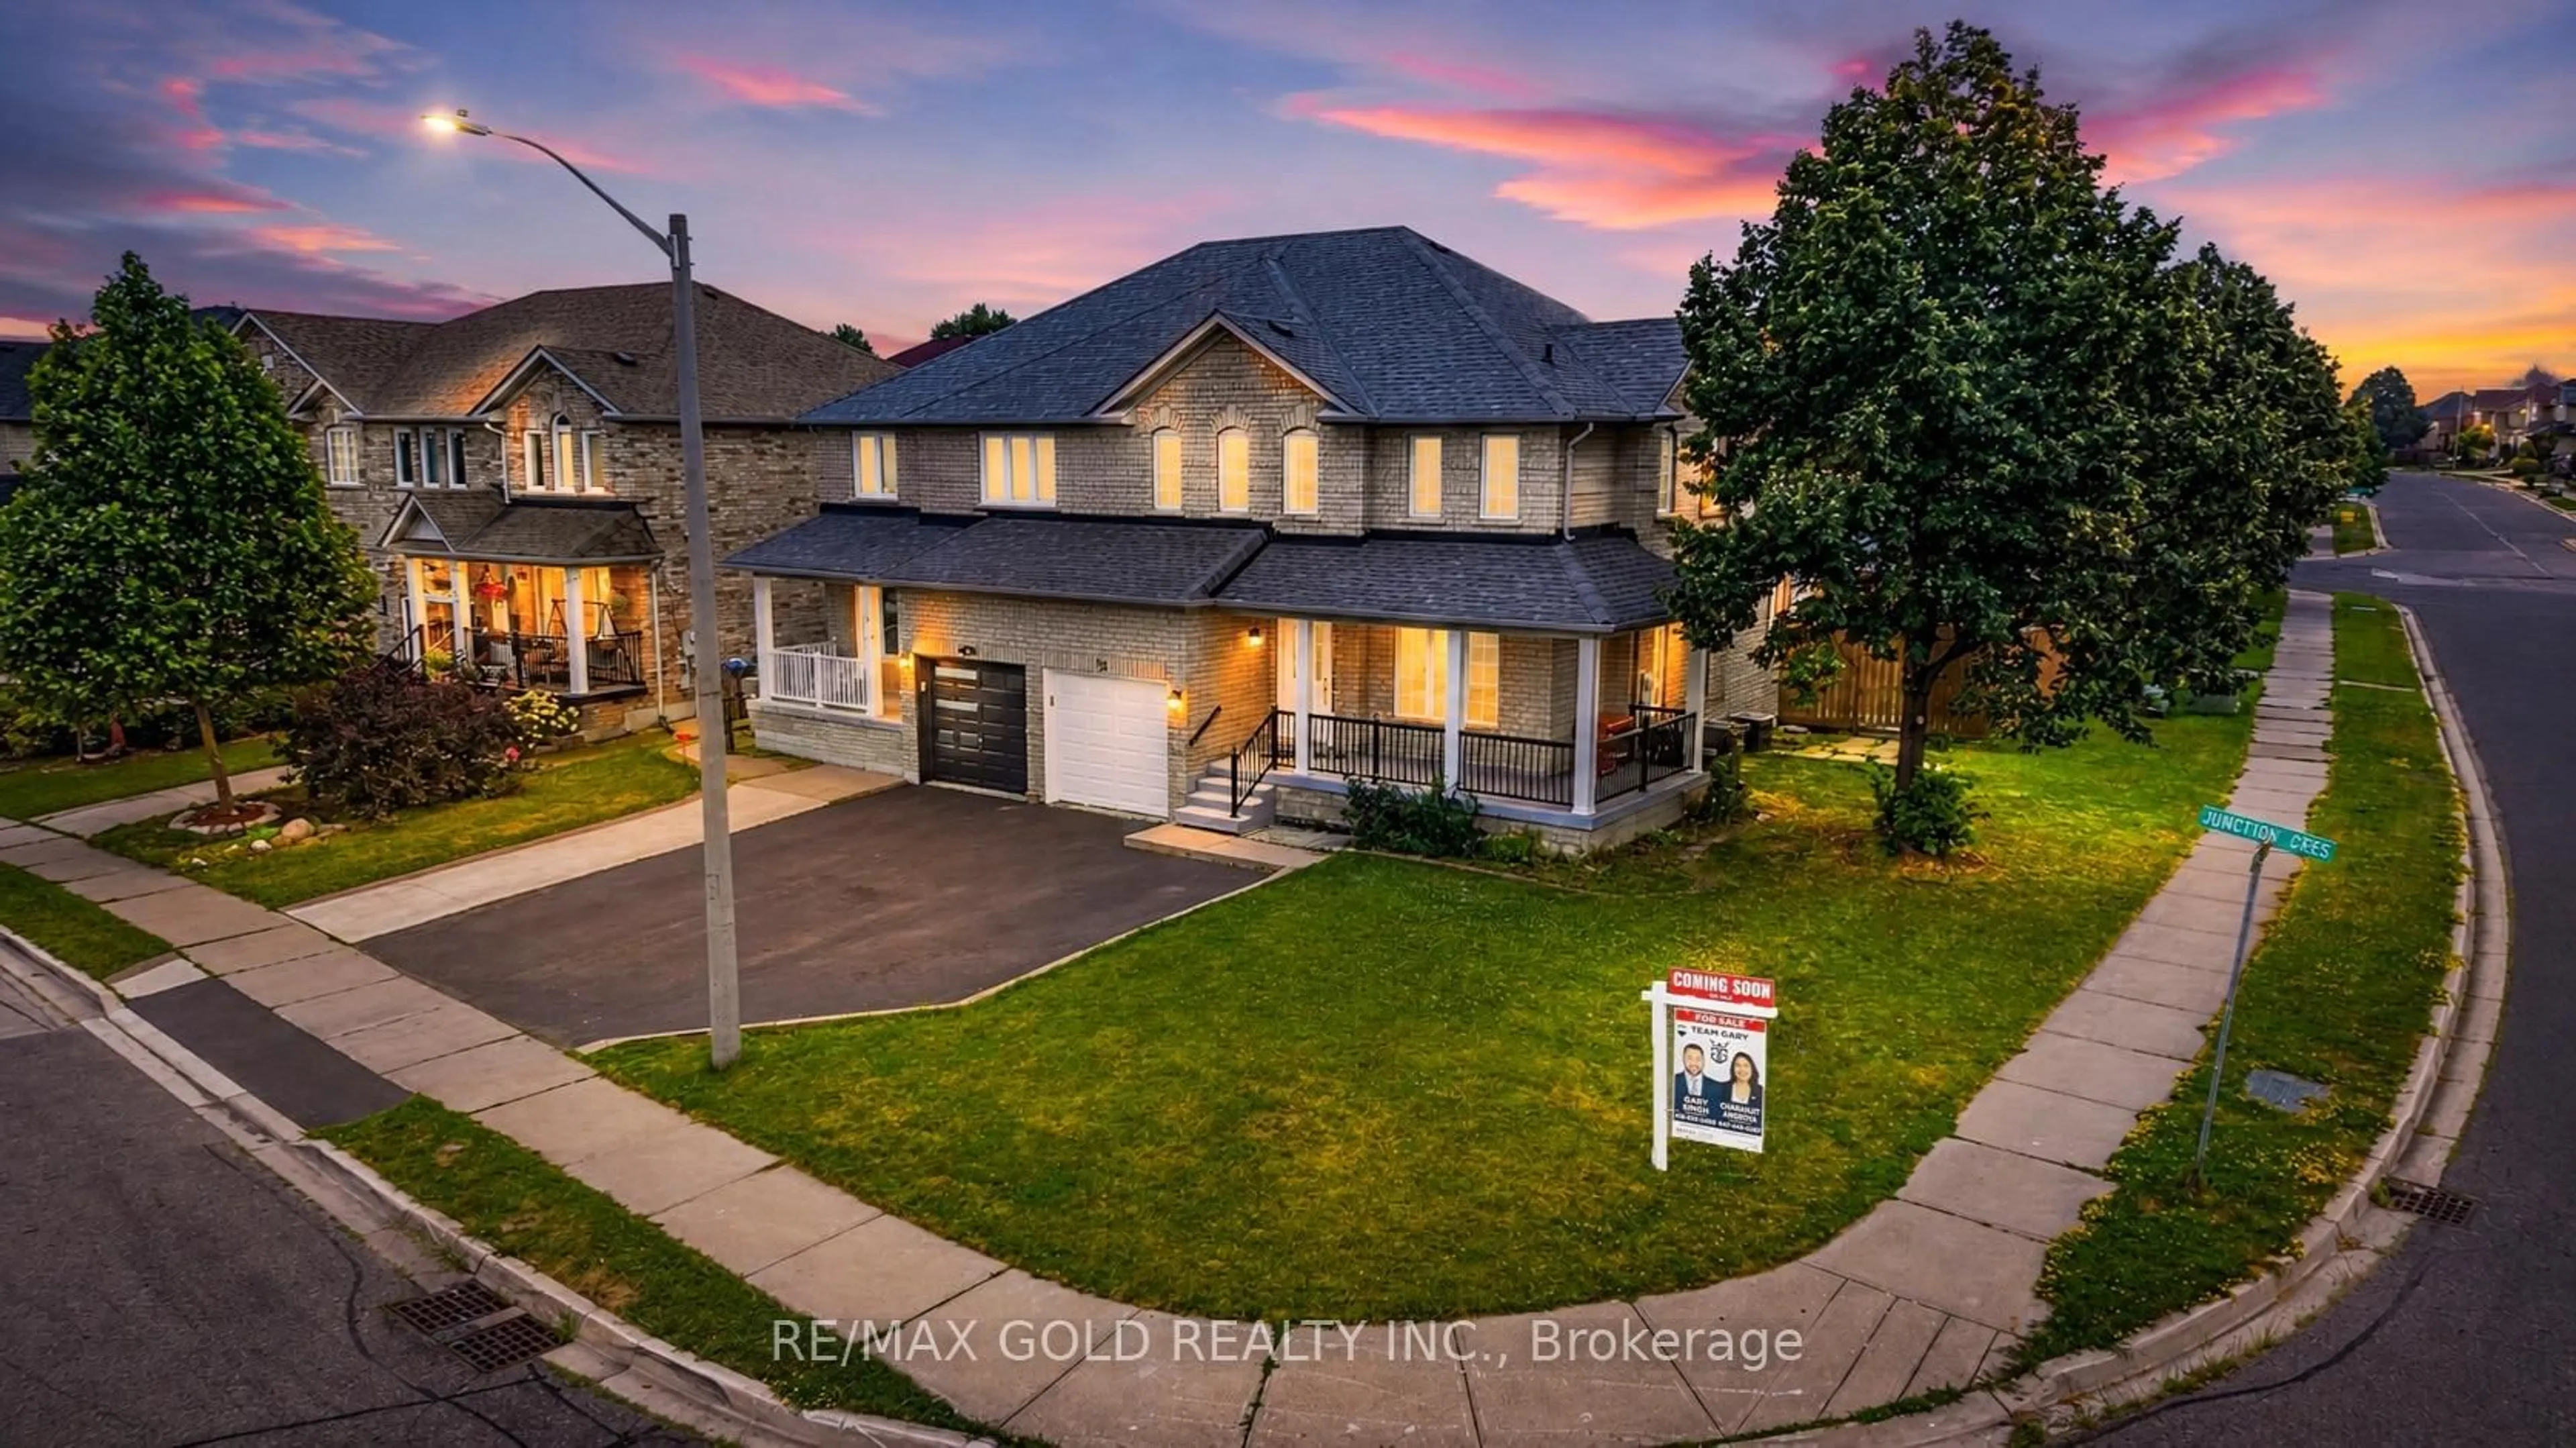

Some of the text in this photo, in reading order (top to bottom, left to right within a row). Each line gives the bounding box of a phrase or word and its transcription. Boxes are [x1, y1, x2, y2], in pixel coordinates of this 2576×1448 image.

[2202, 811, 2278, 841] JUNCTION
[1673, 972, 1771, 998] COMING SOON
[1695, 1014, 1746, 1028] FOR SALE
[1691, 1026, 1719, 1036] TEAM
[1721, 1031, 1748, 1040] GARY
[1684, 1096, 1709, 1105] GARY
